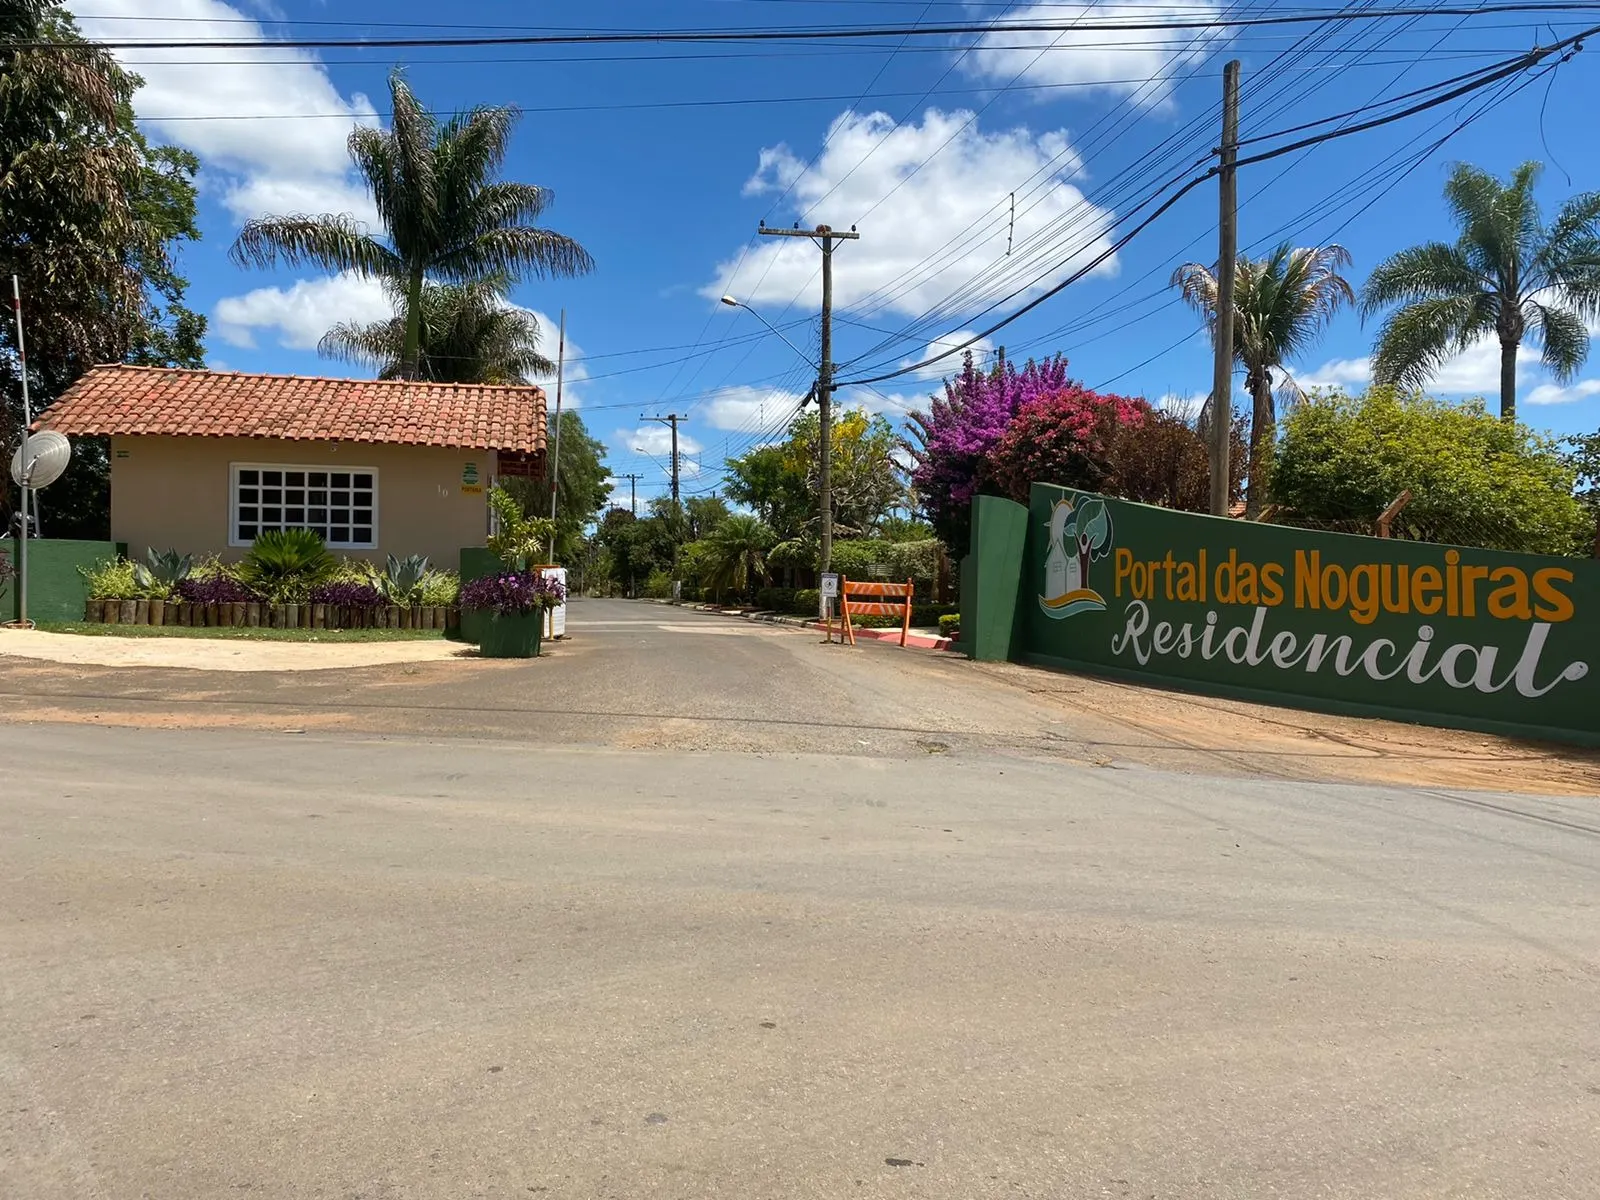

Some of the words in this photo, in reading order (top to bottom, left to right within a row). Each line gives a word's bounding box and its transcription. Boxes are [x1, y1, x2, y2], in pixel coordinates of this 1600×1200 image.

[1115, 548, 1207, 602] Portal
[1215, 548, 1285, 607] das
[1294, 549, 1575, 624] Nogueiras
[1111, 599, 1589, 698] Residencial
